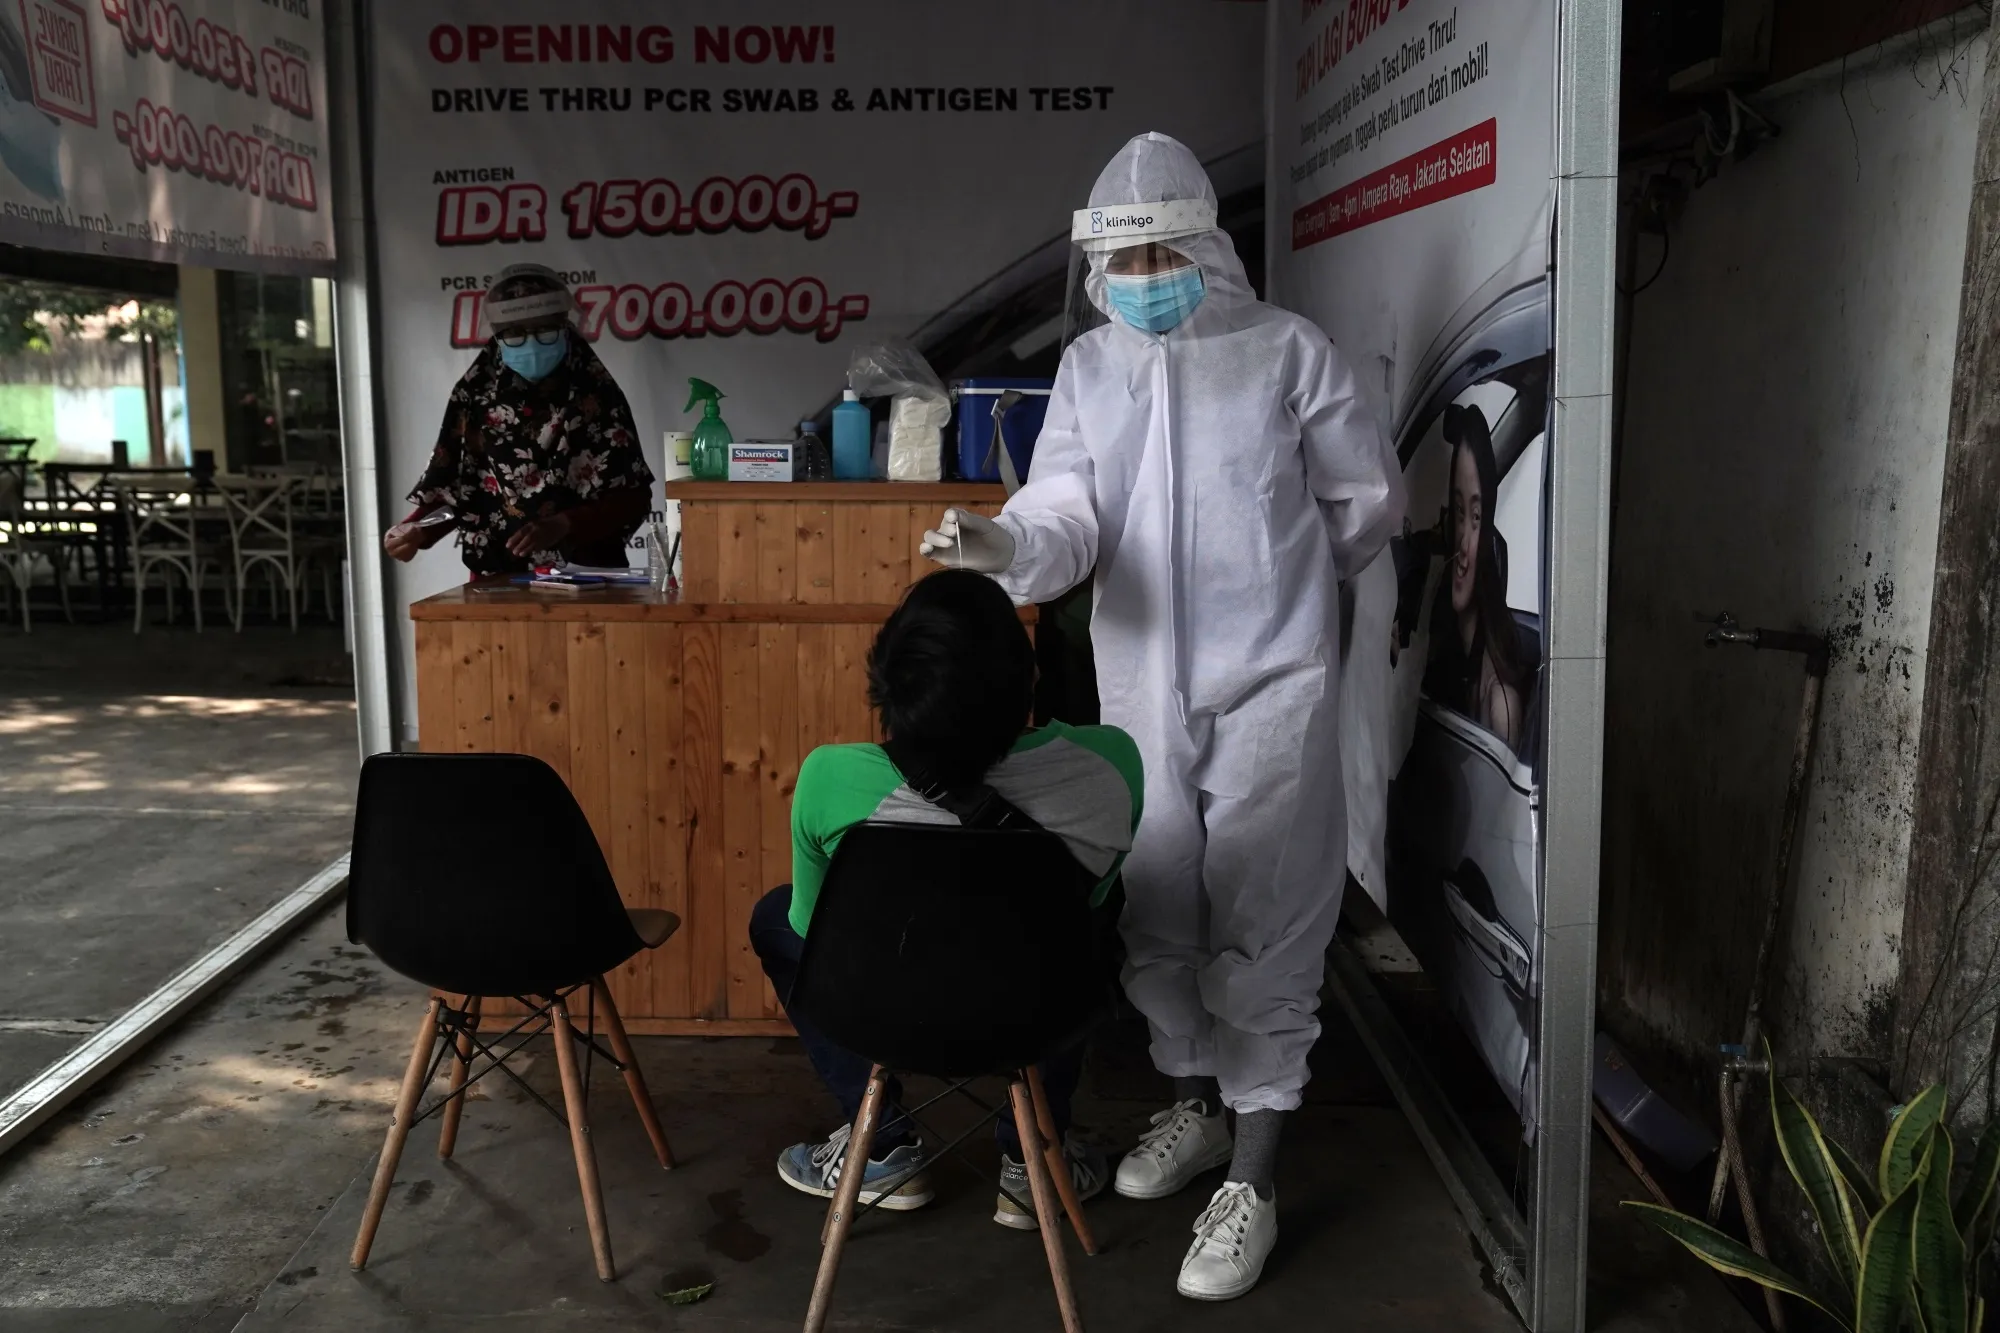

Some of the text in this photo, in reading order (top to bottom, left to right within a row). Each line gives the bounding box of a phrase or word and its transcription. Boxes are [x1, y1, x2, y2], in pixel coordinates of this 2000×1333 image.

[428, 23, 836, 64] OPENING NOW!
[1295, 42, 1316, 102] TAPI
[1317, 10, 1345, 83] LAGI
[1352, 81, 1361, 107] ke
[1361, 64, 1381, 101] Swab
[1382, 50, 1400, 86] Test
[1401, 36, 1425, 74] Drive
[1428, 7, 1458, 55] Thru!
[431, 86, 1114, 113] DRIVE THRU PCR SWAB & ANTIGEN TEST
[1355, 111, 1377, 151] nggak
[1378, 98, 1398, 142] perlu
[1400, 88, 1425, 122] turun
[1428, 66, 1448, 107] dari
[1451, 41, 1489, 95] mobil!
[432, 167, 515, 185] ANTIGEN
[1361, 181, 1388, 214] Ampera
[1389, 172, 1411, 206] Raya,
[1413, 155, 1447, 191] Jakarta
[1449, 139, 1490, 178] Selatan
[436, 173, 859, 246] IDR 150.000,-
[1106, 214, 1154, 228] klinikgo
[440, 276, 478, 291] PCR
[557, 270, 597, 285] ROM
[574, 276, 869, 344] 700.000,-
[735, 449, 785, 459] Shamrock
[1002, 1170, 1029, 1181] balance
[1008, 1166, 1023, 1174] new
